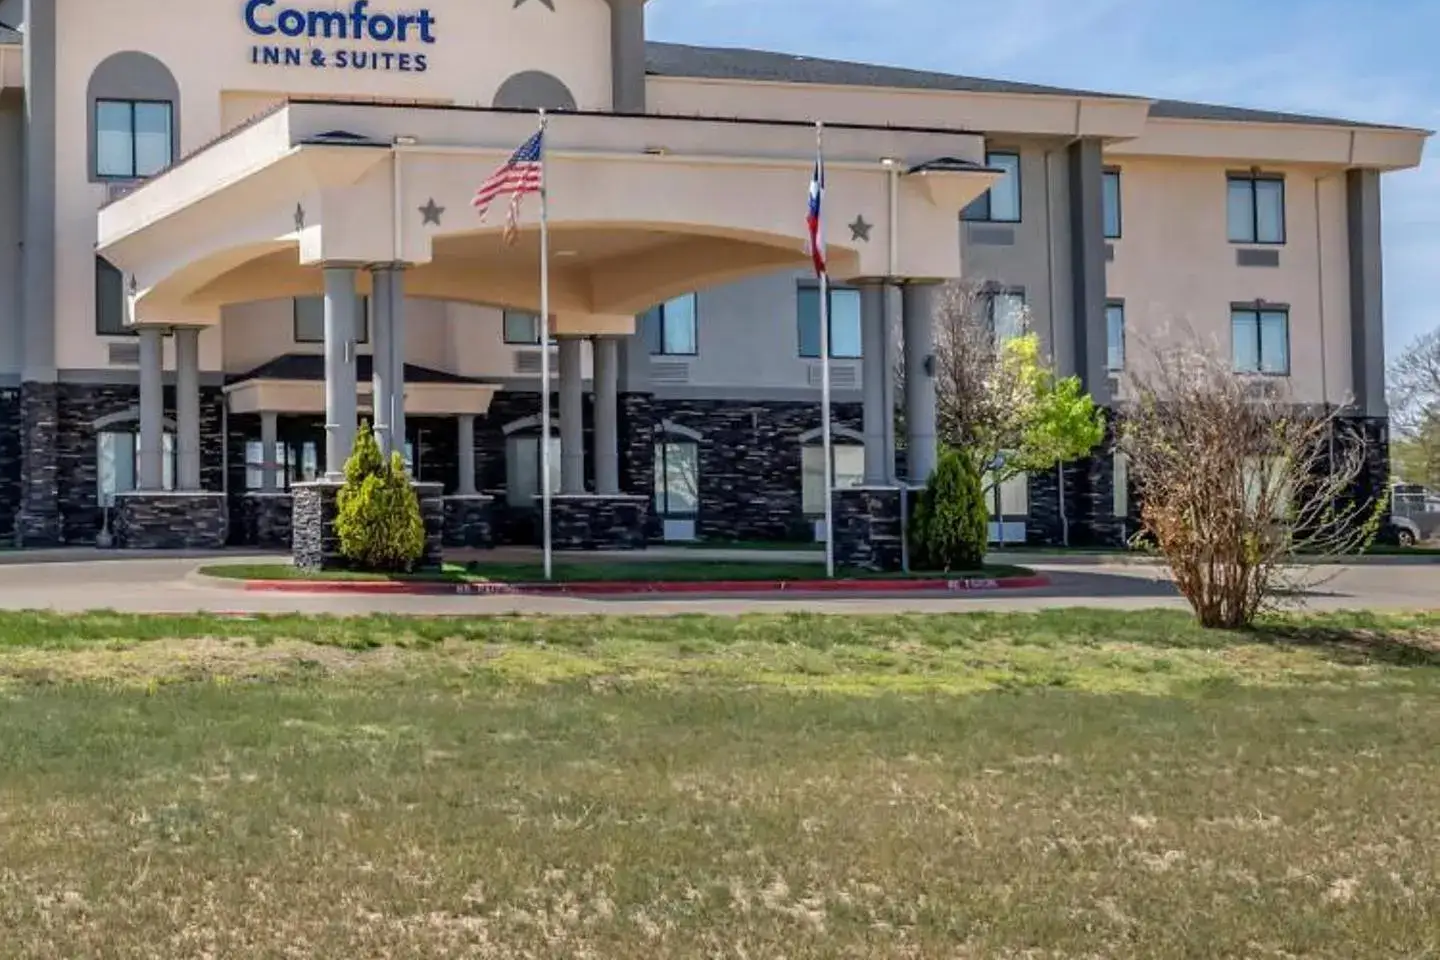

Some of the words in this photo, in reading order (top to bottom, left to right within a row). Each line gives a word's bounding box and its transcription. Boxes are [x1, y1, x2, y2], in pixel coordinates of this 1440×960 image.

[251, 45, 301, 67] INN
[310, 48, 326, 68] &
[335, 49, 428, 72] SUITES
